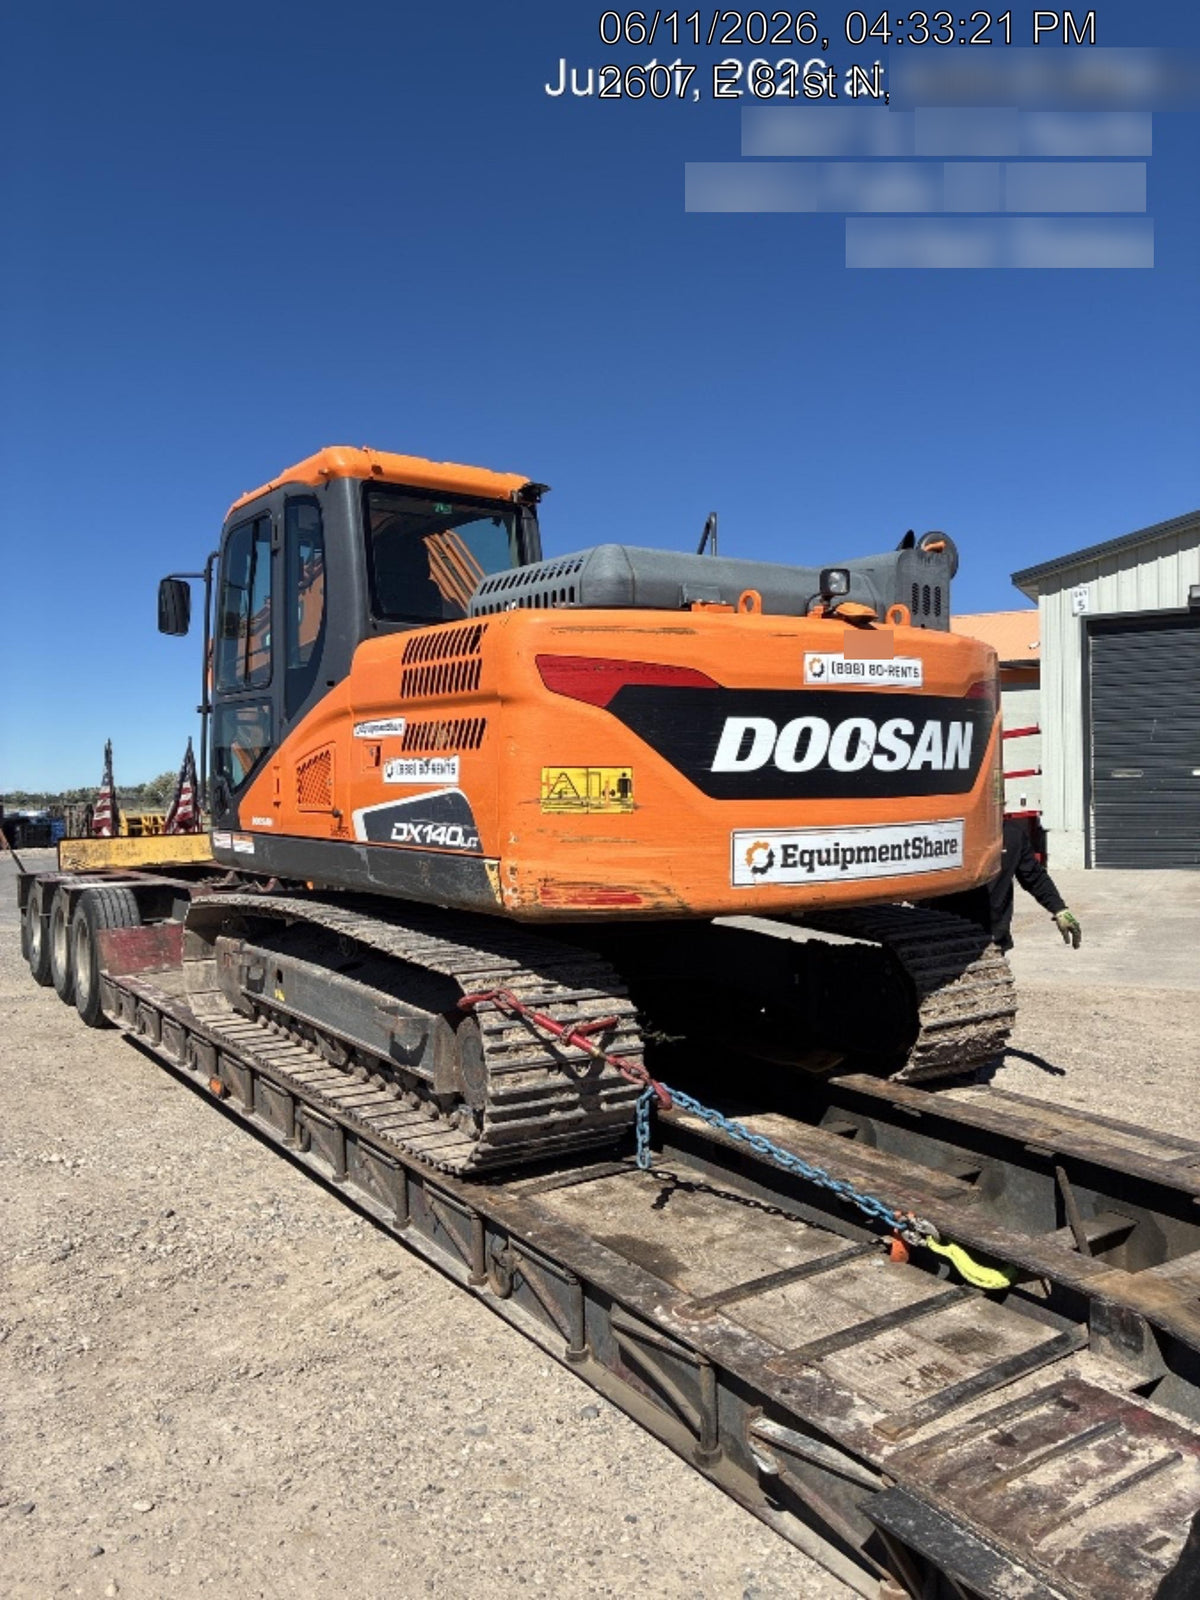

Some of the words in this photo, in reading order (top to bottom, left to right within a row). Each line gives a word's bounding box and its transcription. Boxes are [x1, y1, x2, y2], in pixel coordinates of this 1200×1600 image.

[1078, 600, 1086, 611] 5
[868, 664, 920, 678] 80-RENTS
[711, 716, 974, 772] DOOSAN
[780, 836, 958, 873] EquipmentShare
